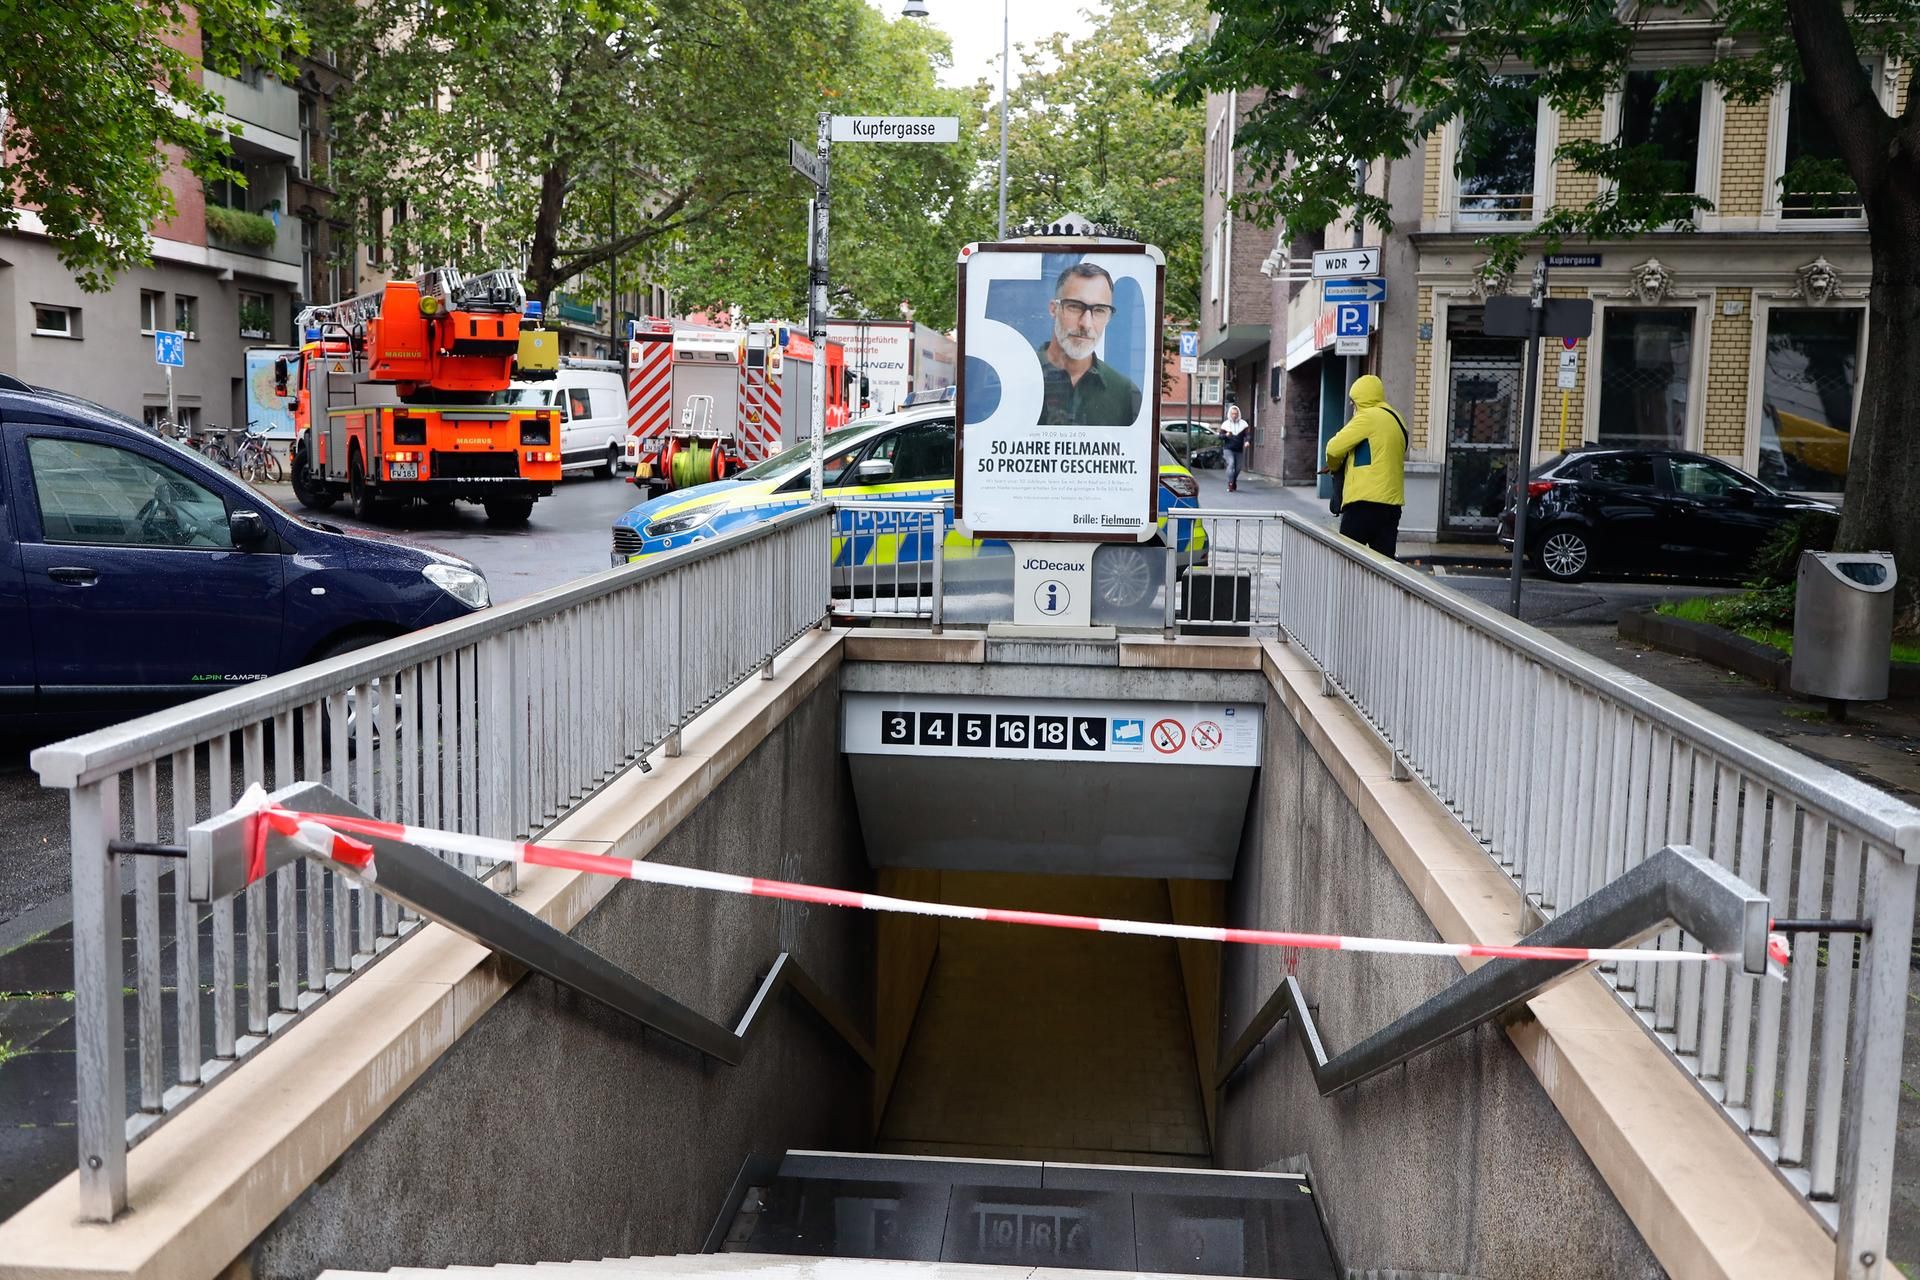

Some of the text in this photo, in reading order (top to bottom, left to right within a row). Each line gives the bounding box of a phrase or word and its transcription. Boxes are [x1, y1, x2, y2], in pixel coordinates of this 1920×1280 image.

[853, 120, 935, 138] Kupfergasse
[1325, 258, 1348, 270] WDR
[1341, 308, 1359, 333] P
[826, 335, 898, 345] emperaturgeführte
[844, 347, 879, 355] ansporte
[991, 440, 1125, 456] 50 JAHRE FIELMANN.
[978, 458, 1138, 474] 50 PROZENT GESCHENKT.
[858, 510, 932, 526] POLIZE
[1073, 514, 1144, 526] Brille: Fielmann.
[1022, 559, 1085, 572] JCDecaux
[890, 717, 1064, 744] 3 4 5 16 18
